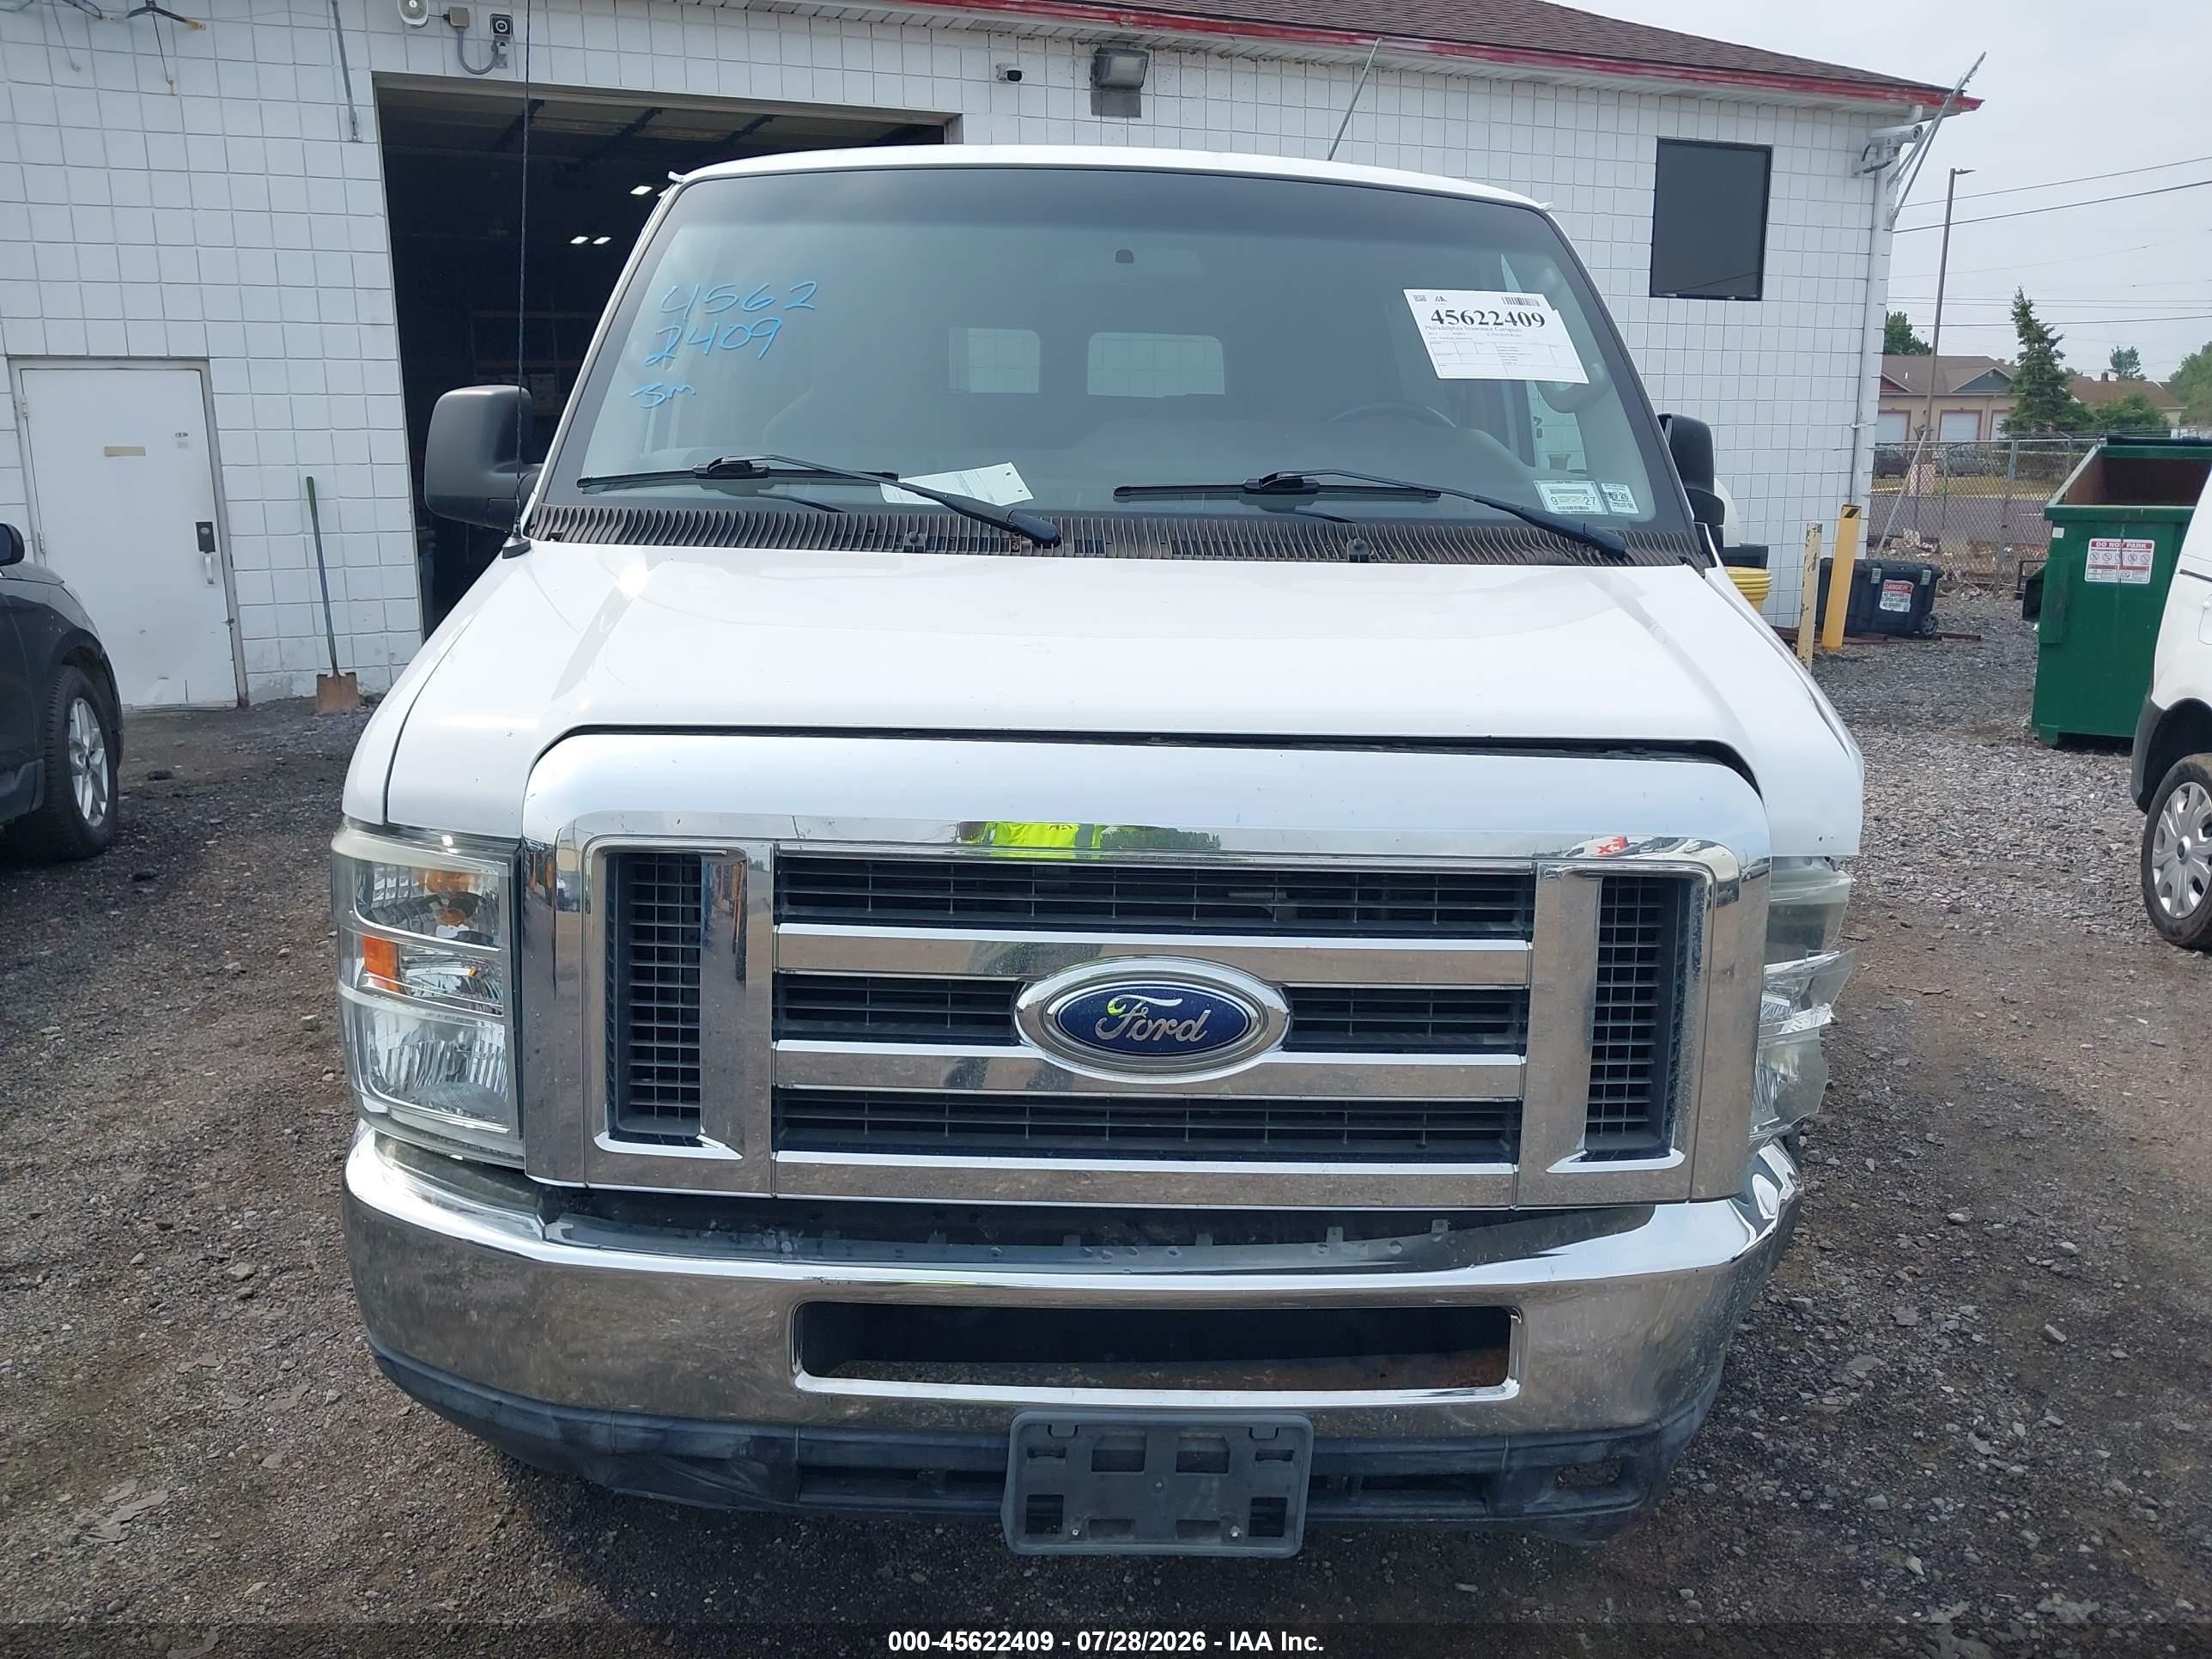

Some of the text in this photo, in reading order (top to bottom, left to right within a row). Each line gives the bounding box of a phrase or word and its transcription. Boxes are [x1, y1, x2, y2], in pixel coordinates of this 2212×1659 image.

[1431, 308, 1546, 328] 45622409
[645, 317, 782, 368] 2409
[1550, 496, 1559, 506] 9
[1583, 496, 1596, 506] 27
[1095, 994, 1212, 1042] Ford
